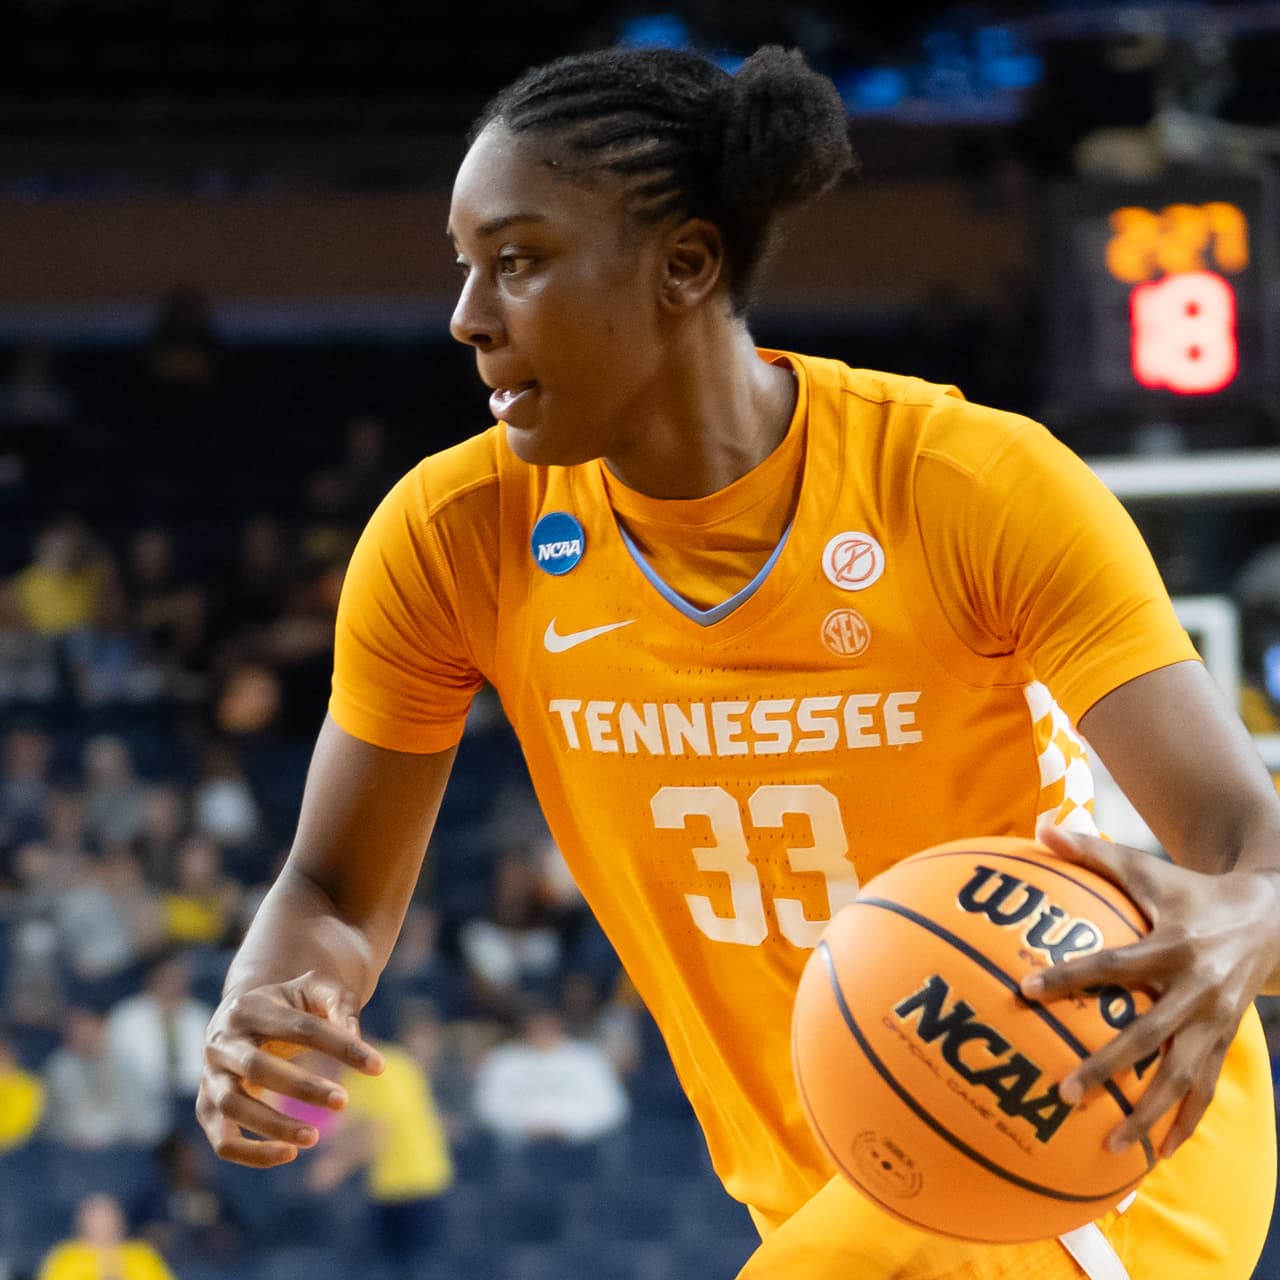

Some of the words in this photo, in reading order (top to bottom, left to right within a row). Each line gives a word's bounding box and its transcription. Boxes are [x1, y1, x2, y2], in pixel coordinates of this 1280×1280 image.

[1129, 270, 1240, 397] 18
[537, 539, 582, 561] NCAA
[824, 612, 867, 655] SEC
[548, 691, 924, 757] TENNESSEE
[650, 784, 861, 950] 33
[956, 864, 1164, 1081] Wilo
[892, 974, 1074, 1146] NCAA
